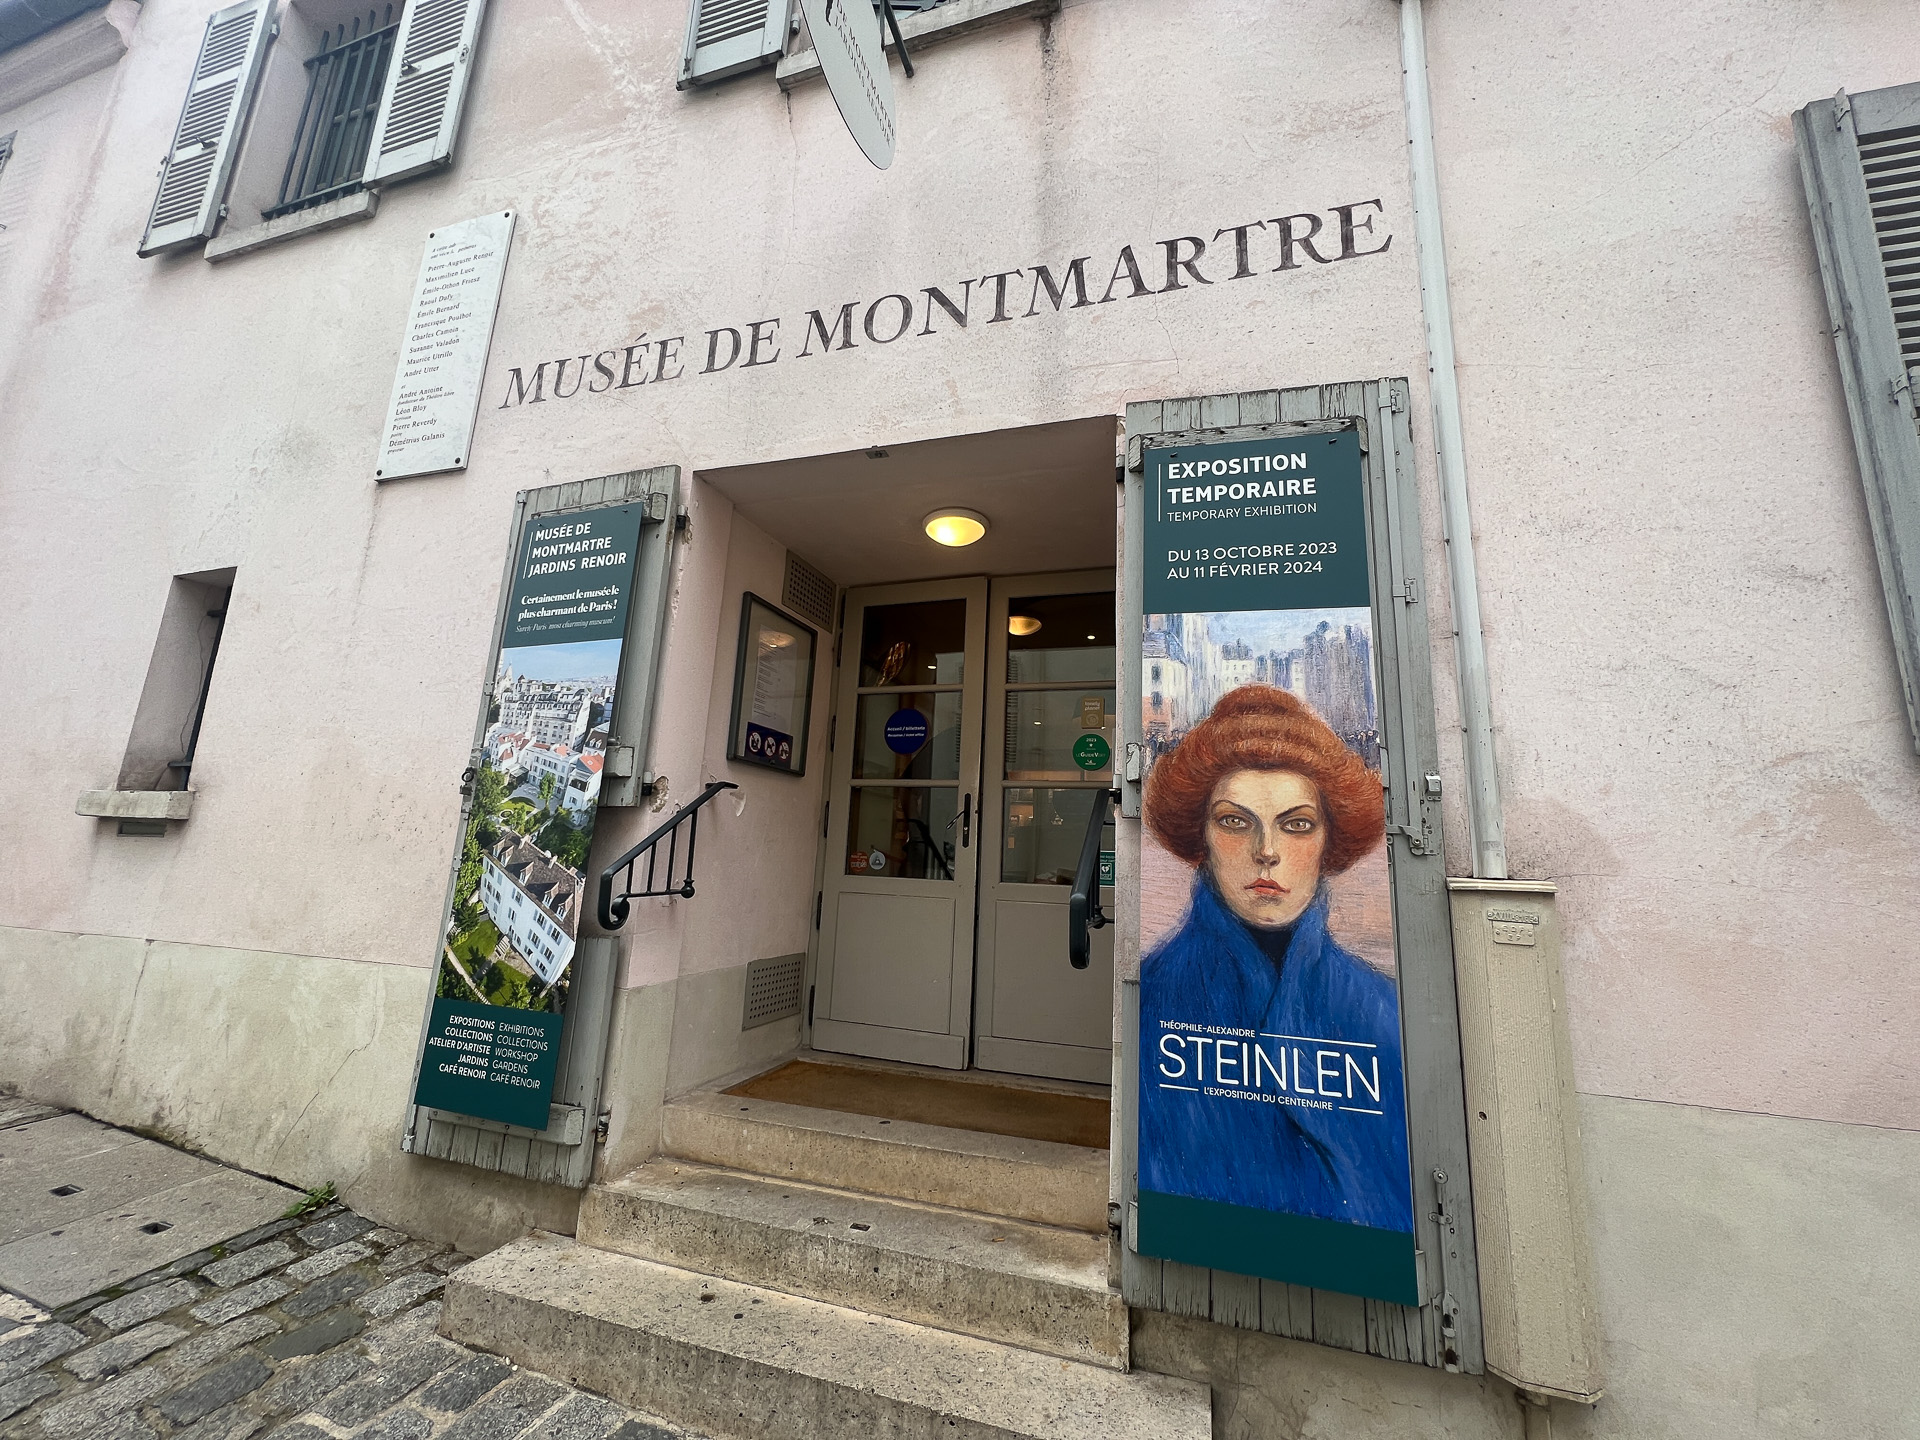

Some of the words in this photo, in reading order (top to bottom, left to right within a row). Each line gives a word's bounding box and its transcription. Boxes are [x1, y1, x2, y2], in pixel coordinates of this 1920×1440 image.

[427, 257, 472, 273] Pierre-Auguste
[472, 251, 494, 260] Renoir
[425, 271, 459, 284] Maximilien
[460, 266, 475, 275] Luce
[461, 276, 480, 286] Friesz
[419, 296, 437, 307] Raoul
[438, 293, 454, 302] Dufy
[498, 332, 686, 409] MUSÉE
[698, 317, 782, 375] DE
[795, 197, 1393, 359] MONTMARTRE
[414, 318, 447, 330] Francisque
[447, 311, 472, 323] Poulbot
[417, 308, 435, 319] Émile
[435, 302, 461, 314] Bernard
[411, 332, 434, 342] Charles
[435, 326, 459, 337] Camoin
[409, 343, 434, 354] Suzanne
[435, 338, 460, 348] Valadon
[406, 355, 431, 366] Maurice
[432, 350, 453, 360] Utrillo
[403, 368, 422, 378] André
[423, 365, 440, 374] Utter
[398, 390, 417, 400] André
[418, 385, 443, 396] Antoine
[395, 406, 411, 416] Léon
[412, 404, 427, 412] Bloy
[392, 422, 410, 431] Pierre
[411, 417, 437, 428] Reverdy
[421, 431, 445, 442] Galanis
[1167, 452, 1307, 480] EXPOSITION
[1166, 477, 1317, 505] TEMPORAIRE
[1166, 507, 1242, 523] TEMPORARY
[1243, 502, 1318, 518] EXHIBITION
[534, 523, 574, 542] MUSÉE
[575, 522, 592, 536] DE
[531, 536, 613, 559] MONTMARTRE
[1167, 549, 1192, 563] DU
[1194, 548, 1210, 561] 13
[1212, 543, 1295, 560] OCTOBRE
[1298, 541, 1338, 555] 2023
[527, 558, 576, 579] JARDINS
[580, 551, 627, 570] RENOIR
[1166, 566, 1190, 580] AU
[1193, 565, 1206, 578] 11
[1208, 561, 1280, 578] FÉVRIER
[1283, 560, 1324, 575] 2024
[520, 591, 576, 606] Certainement
[576, 589, 583, 600] le
[583, 586, 612, 598] musée
[611, 584, 620, 596] le
[517, 607, 536, 622] plus
[536, 605, 577, 618] charmant
[577, 602, 589, 614] de
[561, 619, 588, 629] charming
[449, 1014, 496, 1030] EXPOSITIONS
[498, 1022, 545, 1038] EXHIBITIONS
[1159, 1019, 1256, 1038] THÉOPHILE-ALEXANDRE
[428, 1036, 456, 1049] ATELIER
[456, 1041, 491, 1055] D'ARTISTE
[494, 1047, 539, 1062] WORKSHOP
[444, 1026, 494, 1043] COLLECTIONS
[496, 1034, 549, 1052] COLLECTIONS
[457, 1053, 489, 1067] JARDINS
[492, 1059, 529, 1075] GARDENS
[1158, 1033, 1380, 1103] STEINLEN
[438, 1063, 458, 1075] CAFÉ
[458, 1066, 487, 1080] RENOIR
[489, 1071, 510, 1085] CAFÉ
[510, 1076, 541, 1090] RENOIR
[1203, 1086, 1261, 1102] L'EXPOSITION
[1262, 1092, 1277, 1104] DU
[1277, 1095, 1334, 1111] CENTENAIRE
